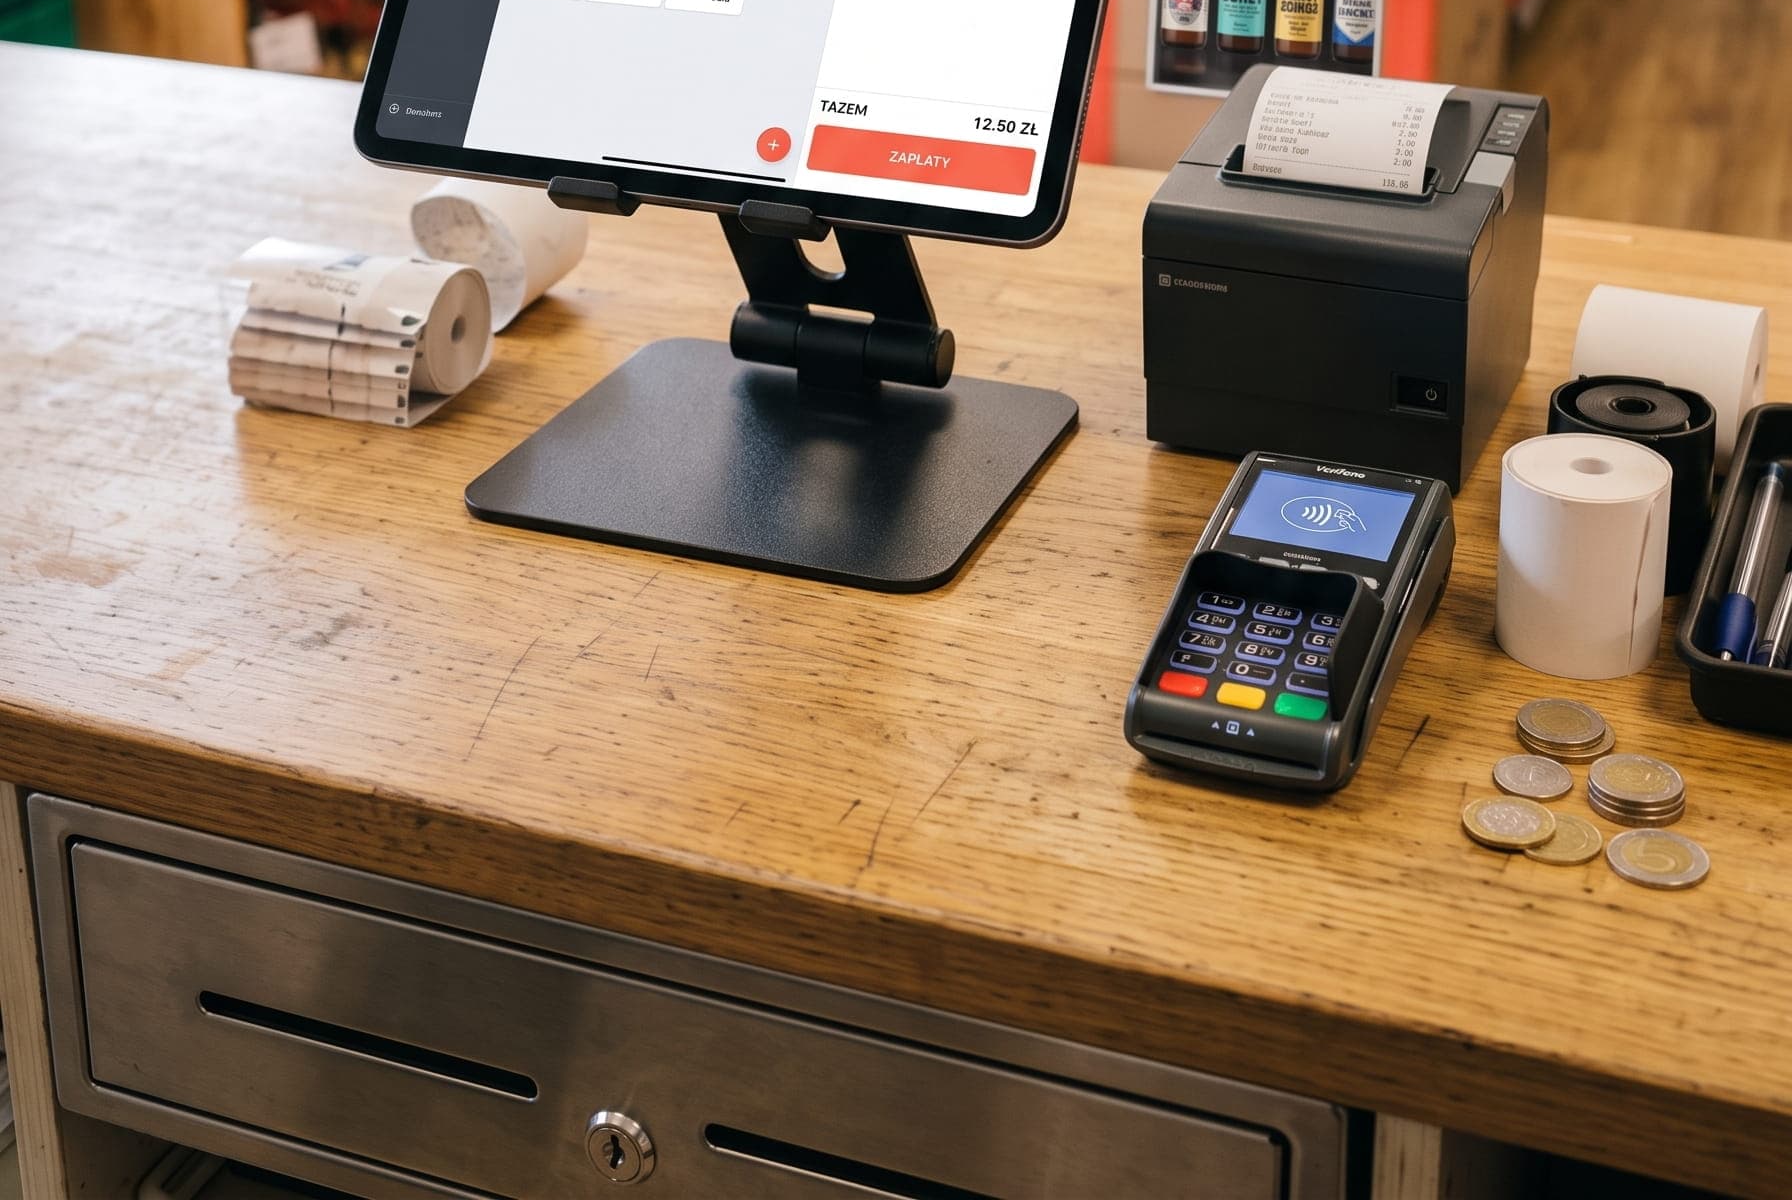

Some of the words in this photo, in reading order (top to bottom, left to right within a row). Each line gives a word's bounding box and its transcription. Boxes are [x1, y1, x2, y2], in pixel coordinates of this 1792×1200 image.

[820, 99, 868, 117] TAZEM
[973, 116, 1016, 134] 12.50
[1019, 122, 1039, 136] ZŁ
[1321, 616, 1333, 626] 3
[1253, 624, 1267, 635] 5
[1311, 634, 1324, 645] 6
[1244, 644, 1257, 655] 8
[1304, 654, 1318, 665] 9
